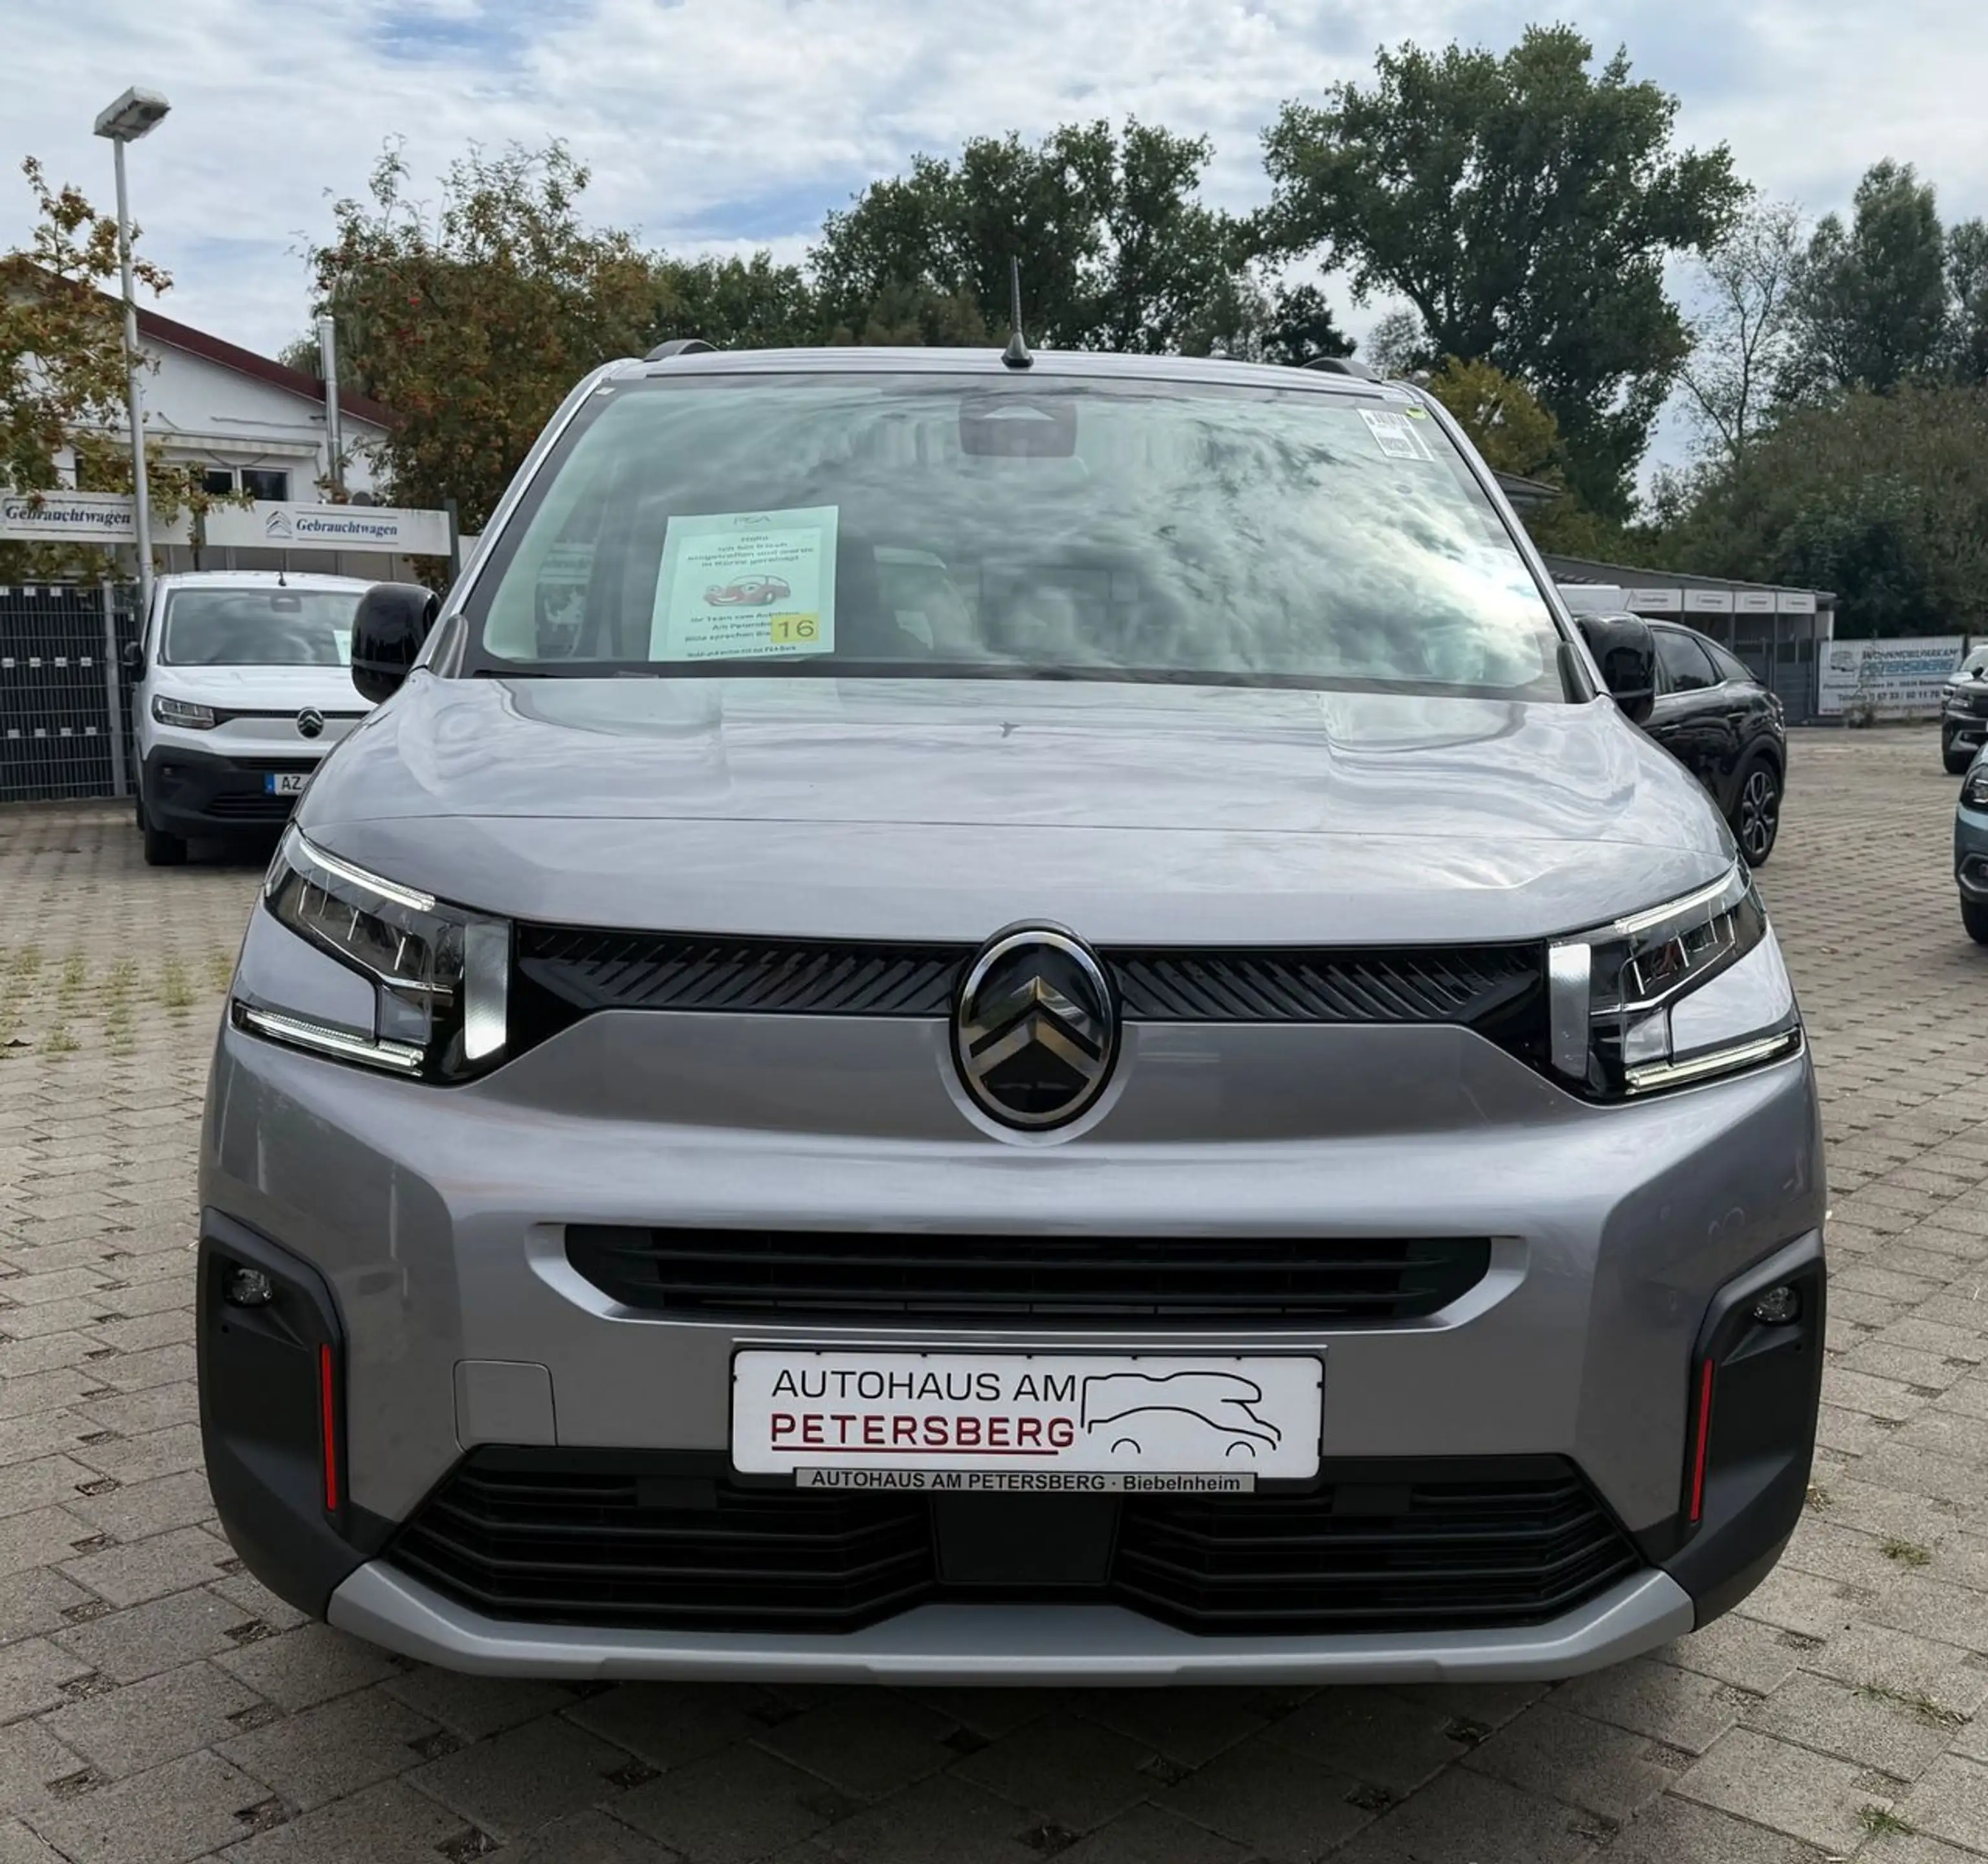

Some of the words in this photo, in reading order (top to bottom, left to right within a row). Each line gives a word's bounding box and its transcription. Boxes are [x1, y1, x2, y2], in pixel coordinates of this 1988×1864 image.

[296, 518, 398, 538] Gebrauchtwagen
[778, 619, 815, 638] 16
[771, 1370, 1000, 1401] AUTOHAUS
[1013, 1374, 1076, 1402] AM
[771, 1413, 1074, 1447] PETERSBERG
[812, 1470, 925, 1488] AUTOHAUS
[931, 1473, 962, 1489] AM
[969, 1474, 1105, 1490] PETERSBERG
[1123, 1475, 1241, 1491] Biebelnheim
